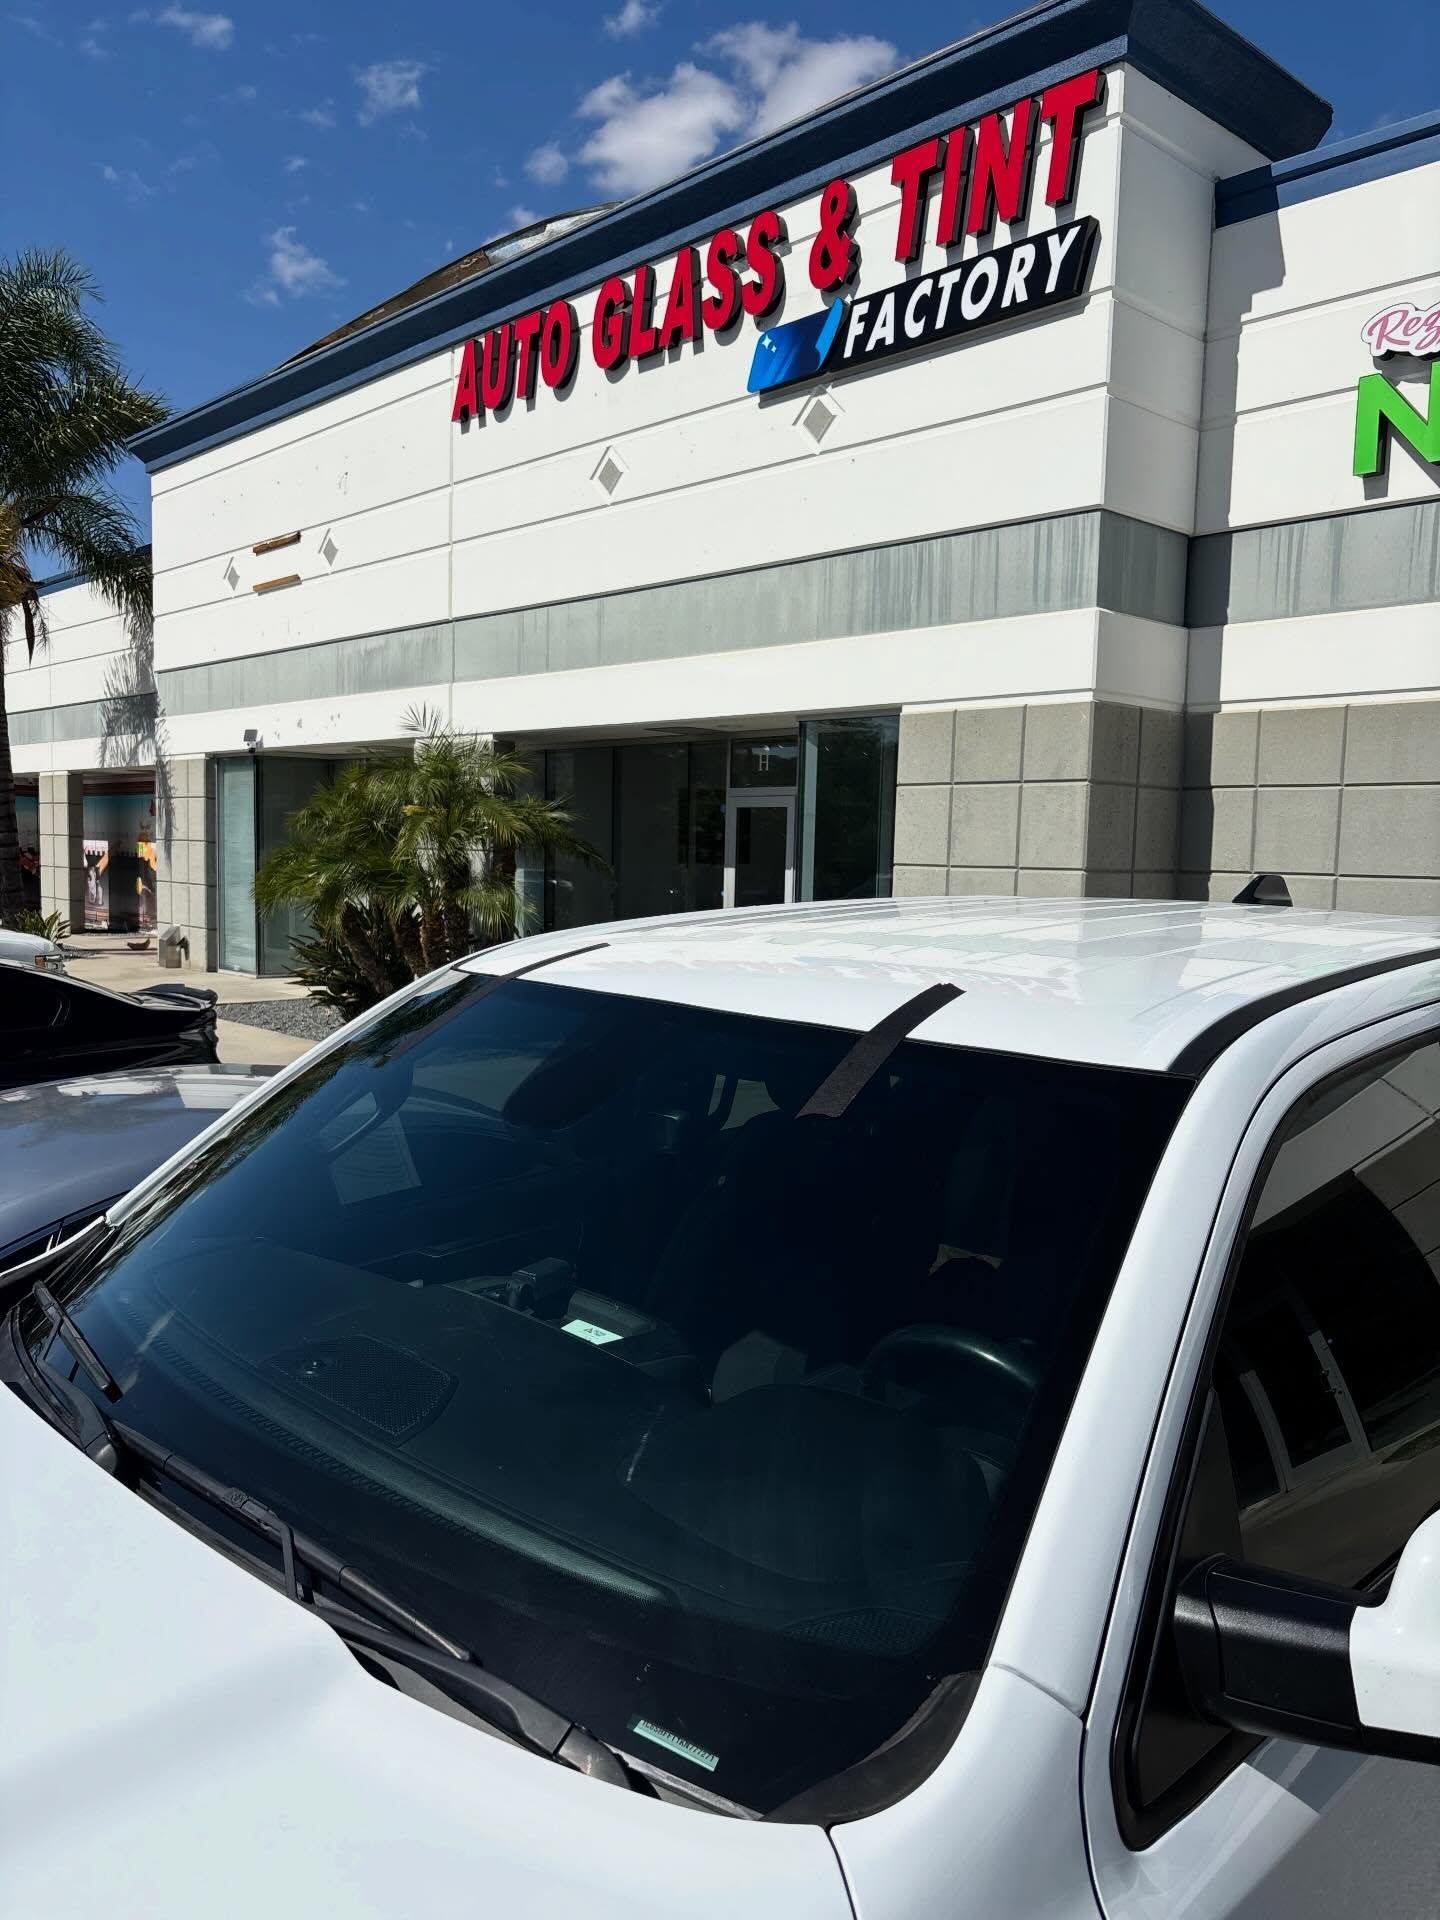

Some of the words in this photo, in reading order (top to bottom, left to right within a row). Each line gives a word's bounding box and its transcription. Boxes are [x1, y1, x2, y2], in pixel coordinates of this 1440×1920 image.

[452, 299, 579, 422] AUTO
[592, 210, 784, 369] GLASS
[809, 179, 858, 291] &
[891, 69, 1104, 262] TINT
[843, 225, 1081, 357] FACTORY
